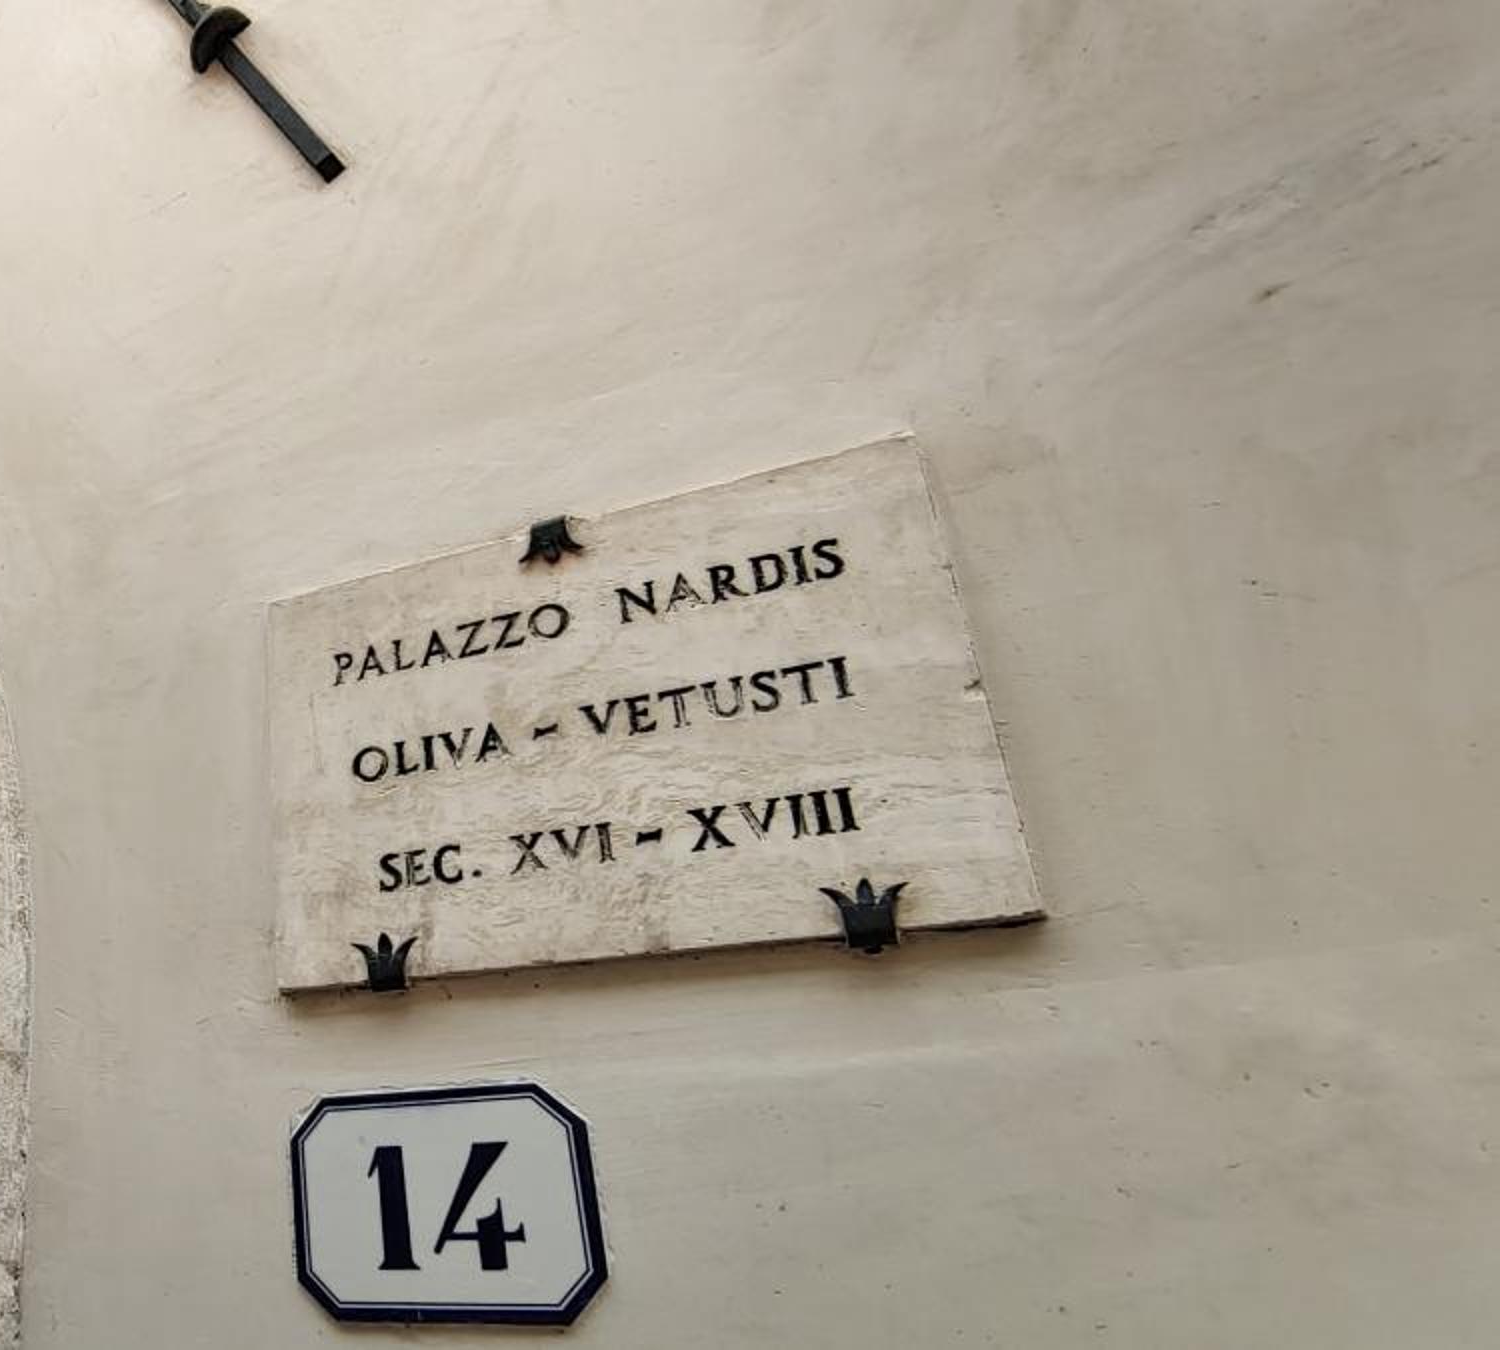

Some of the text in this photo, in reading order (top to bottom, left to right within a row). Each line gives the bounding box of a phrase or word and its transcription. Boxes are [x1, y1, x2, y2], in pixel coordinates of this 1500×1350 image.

[332, 537, 846, 686] PALAZZO NARDIS
[351, 720, 514, 783] OLIVA
[579, 655, 858, 738] VETUSTI
[378, 844, 483, 892] SEC.
[509, 821, 617, 877] XVI
[689, 786, 862, 853] XVIII
[367, 1140, 527, 1271] 14
